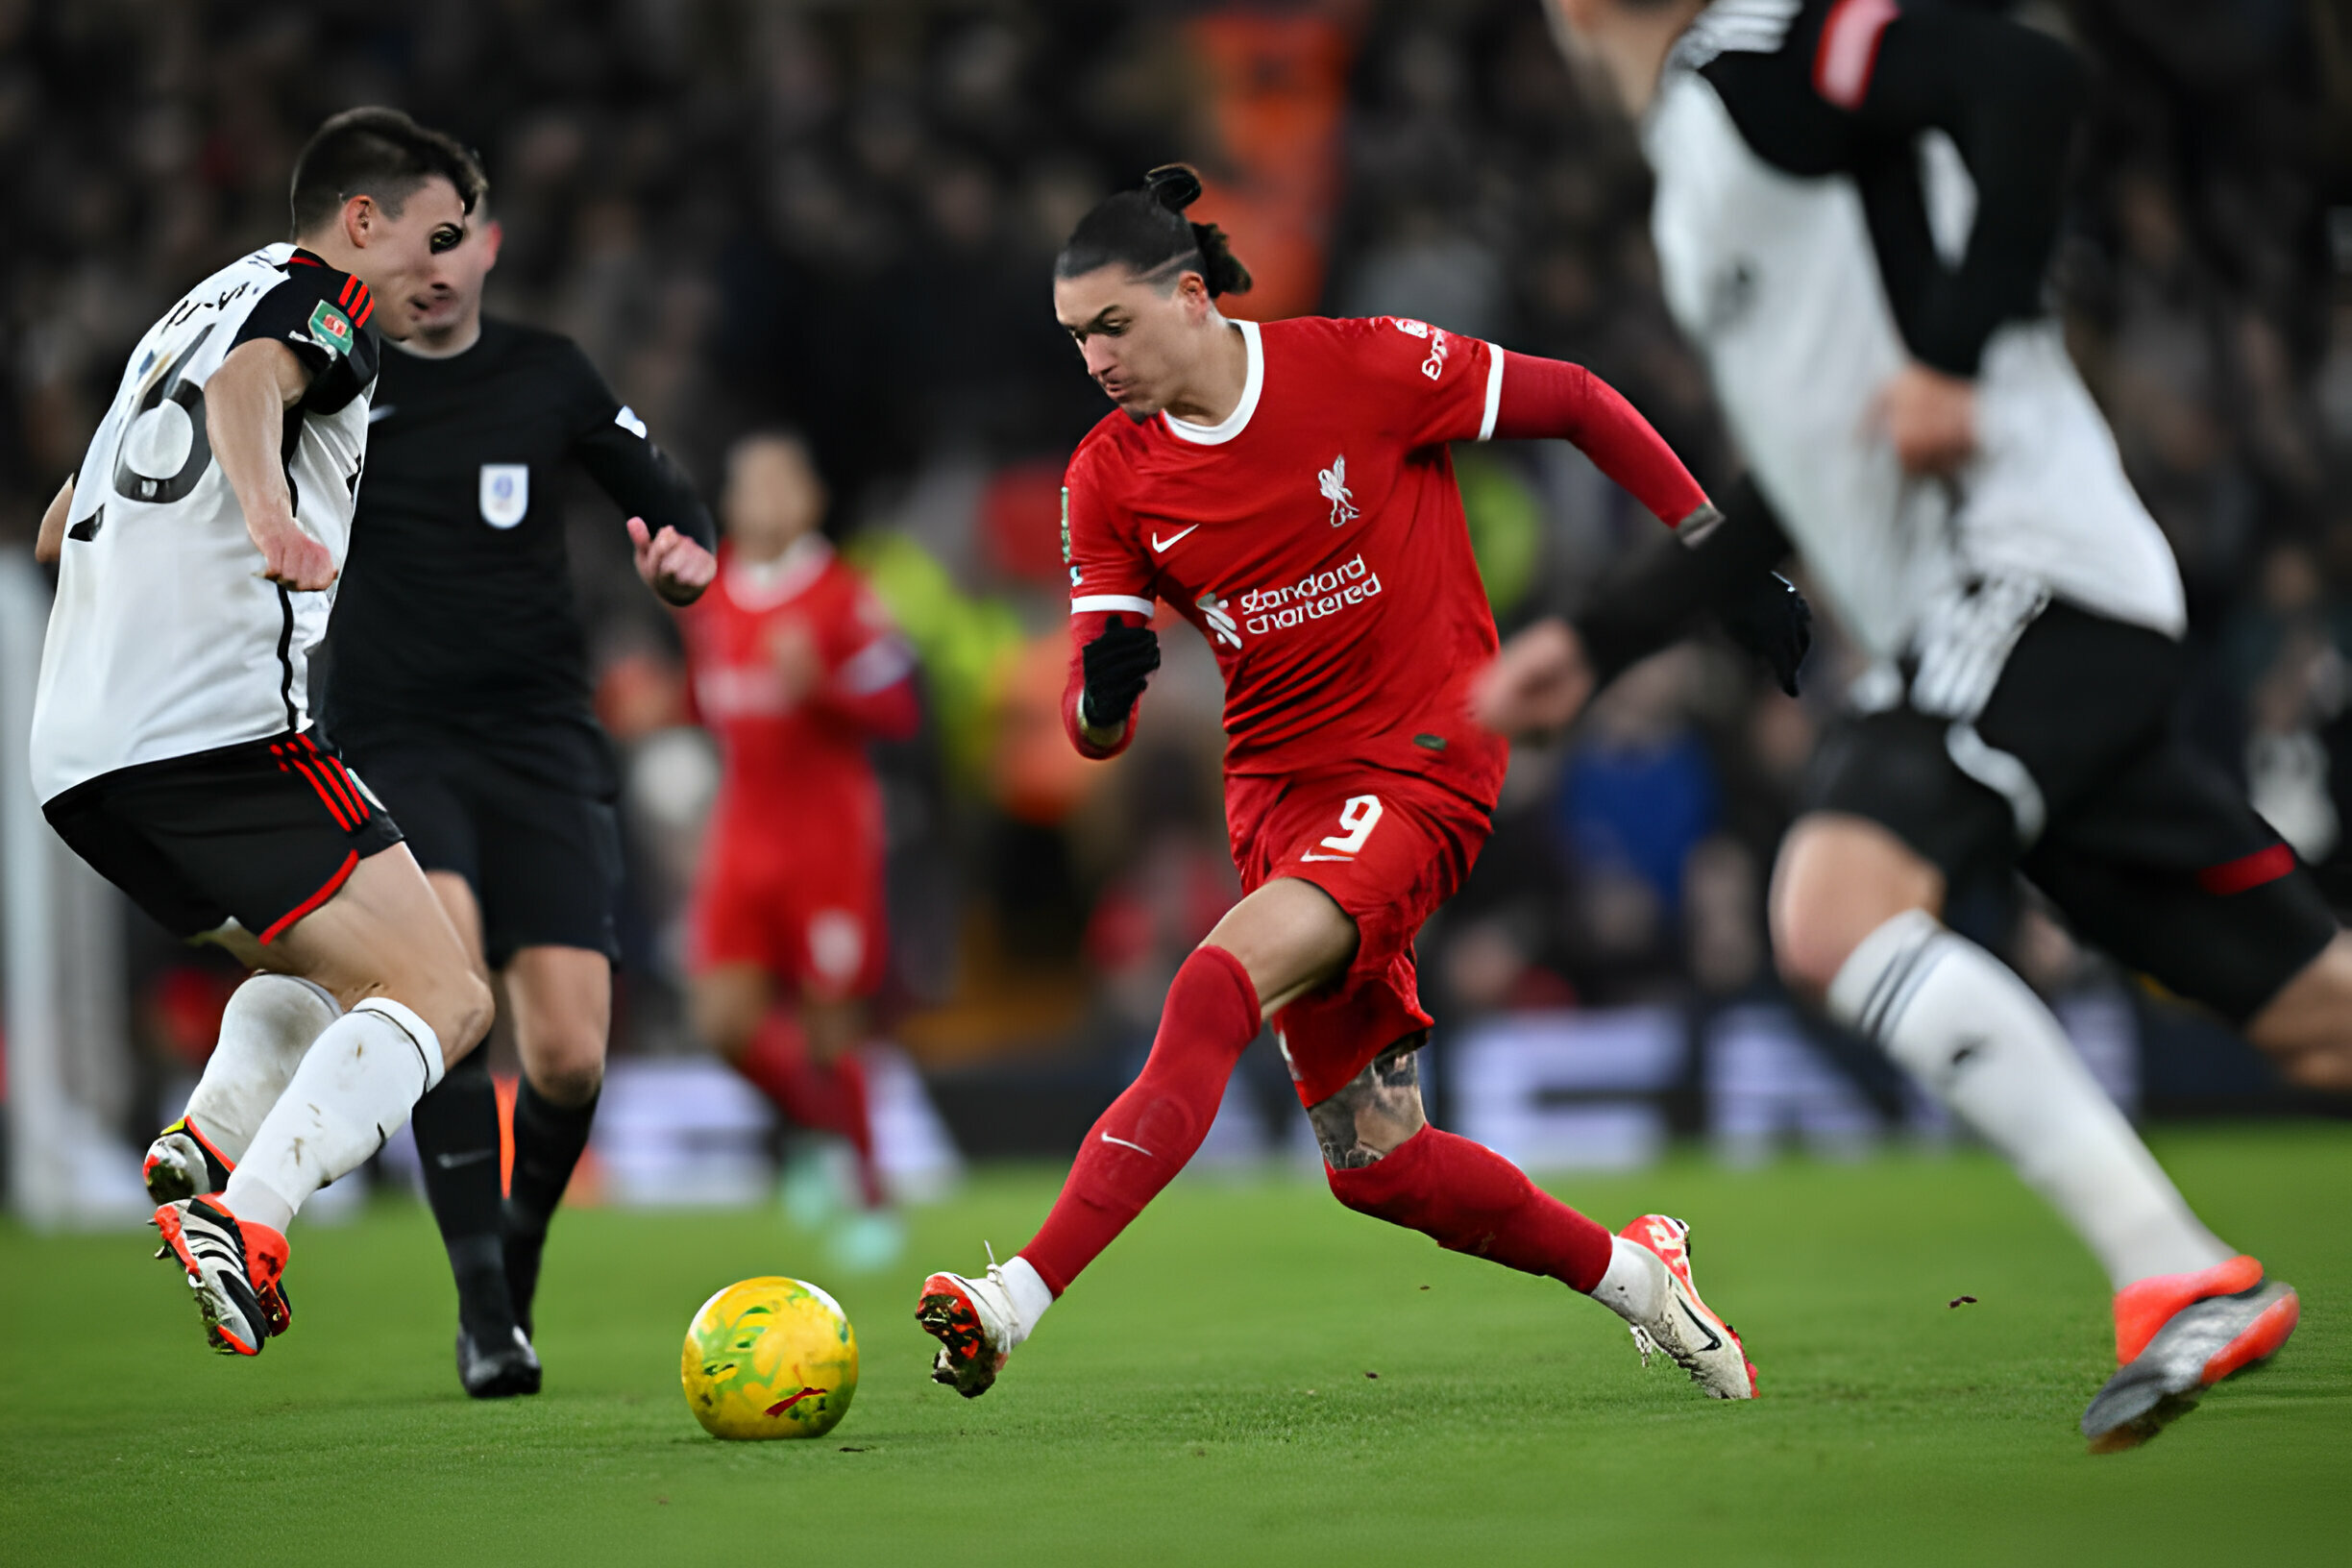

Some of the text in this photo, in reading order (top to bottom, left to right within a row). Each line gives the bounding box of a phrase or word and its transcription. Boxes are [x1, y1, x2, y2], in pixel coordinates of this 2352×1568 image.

[1240, 553, 1366, 615] standard
[1246, 573, 1383, 634] chartered
[1319, 794, 1384, 854] 9
